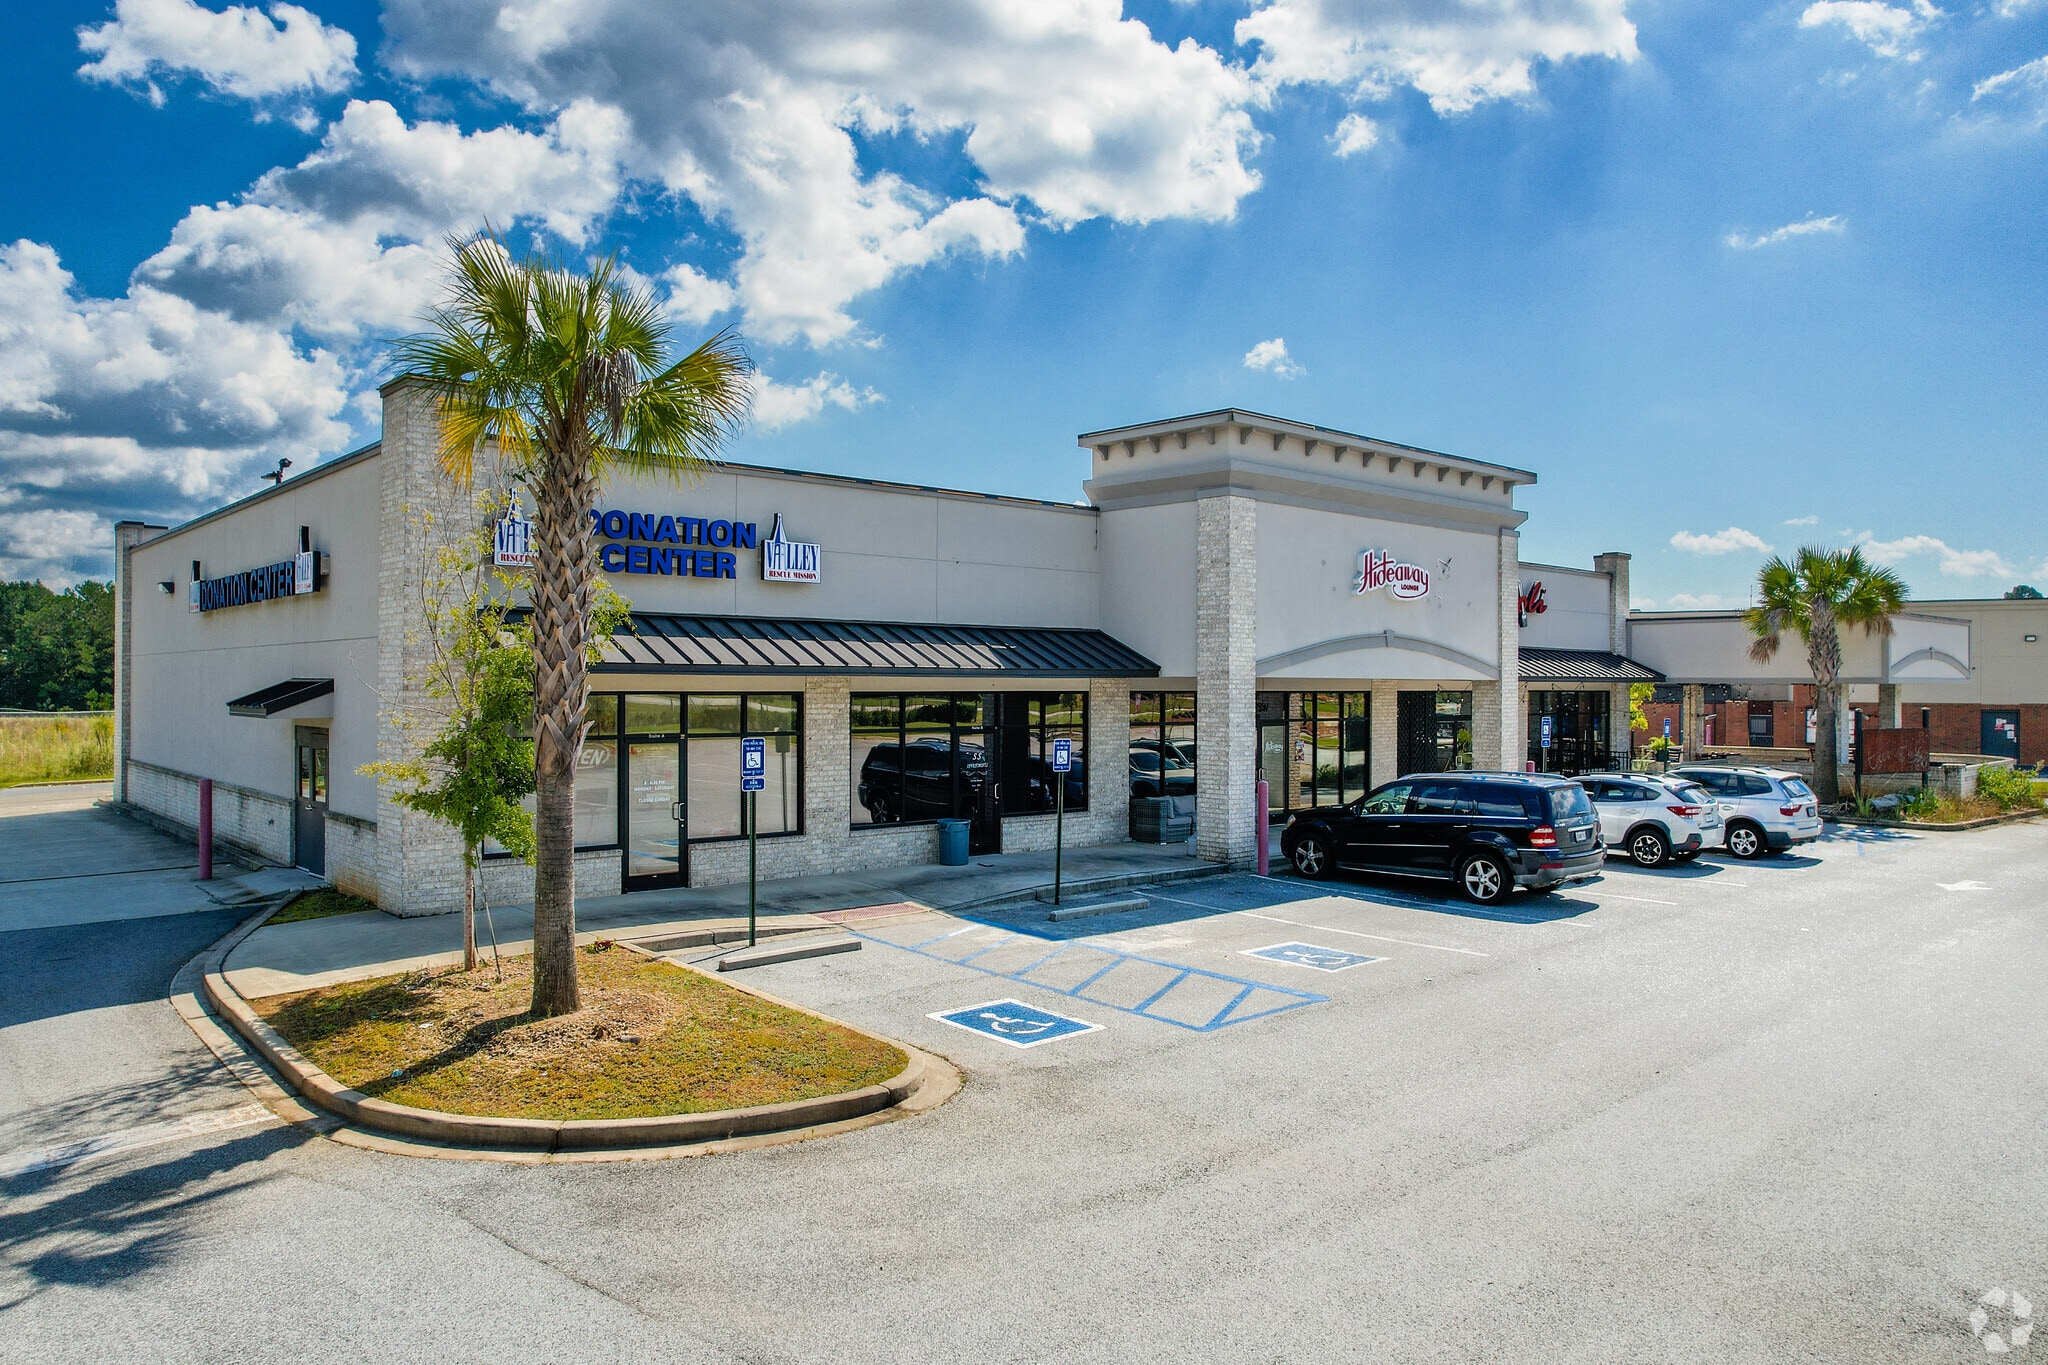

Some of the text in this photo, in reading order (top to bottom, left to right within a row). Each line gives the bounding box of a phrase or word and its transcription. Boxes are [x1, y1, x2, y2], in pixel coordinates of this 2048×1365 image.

[600, 543, 737, 580] CENTER
[766, 541, 820, 571] VALLEY
[201, 561, 295, 612] DONATION CENTER
[768, 570, 817, 580] RESCUE MISSION
[1358, 551, 1429, 599] Hideaway
[579, 747, 605, 766] EN
